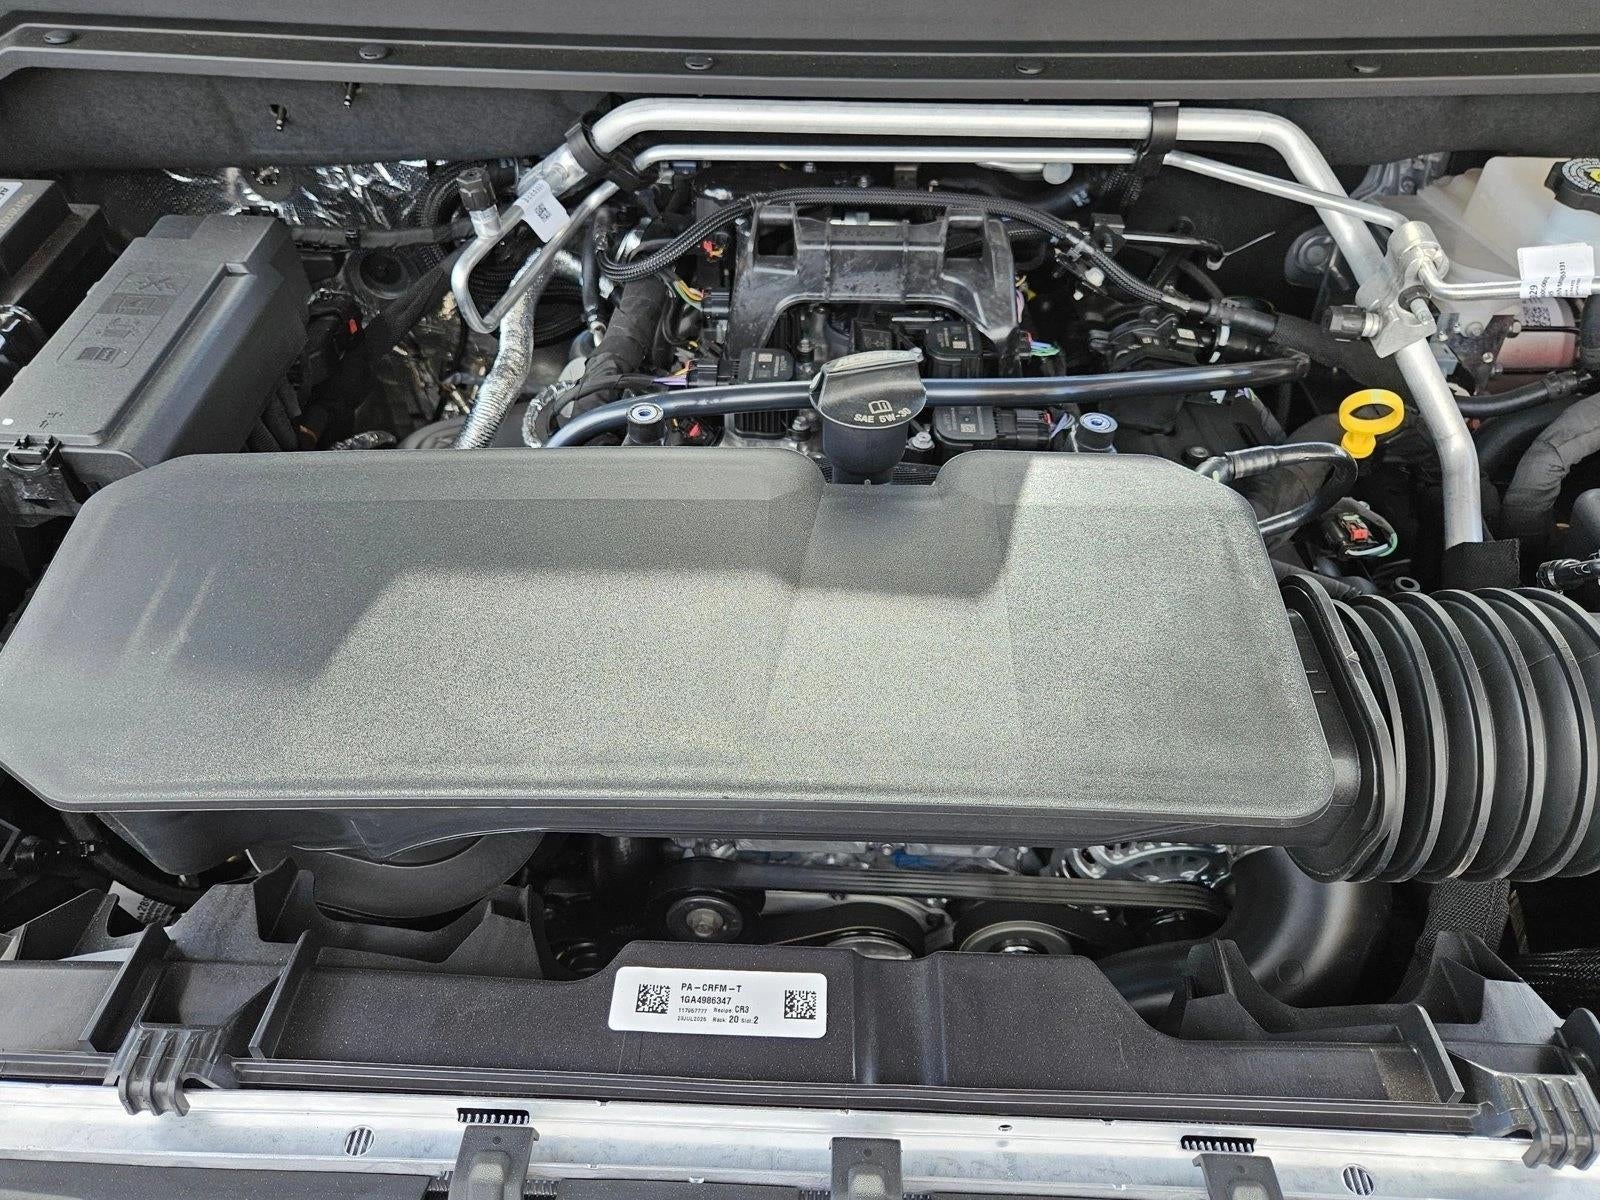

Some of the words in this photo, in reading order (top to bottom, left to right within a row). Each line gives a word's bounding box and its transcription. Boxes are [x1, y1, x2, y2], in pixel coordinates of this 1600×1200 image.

[853, 413, 875, 423] SAE
[879, 407, 912, 423] 5W-30
[680, 995, 732, 1005] 1GA4986347
[734, 1005, 750, 1014] CR3
[728, 1015, 739, 1024] 20
[753, 1015, 759, 1024] 2
